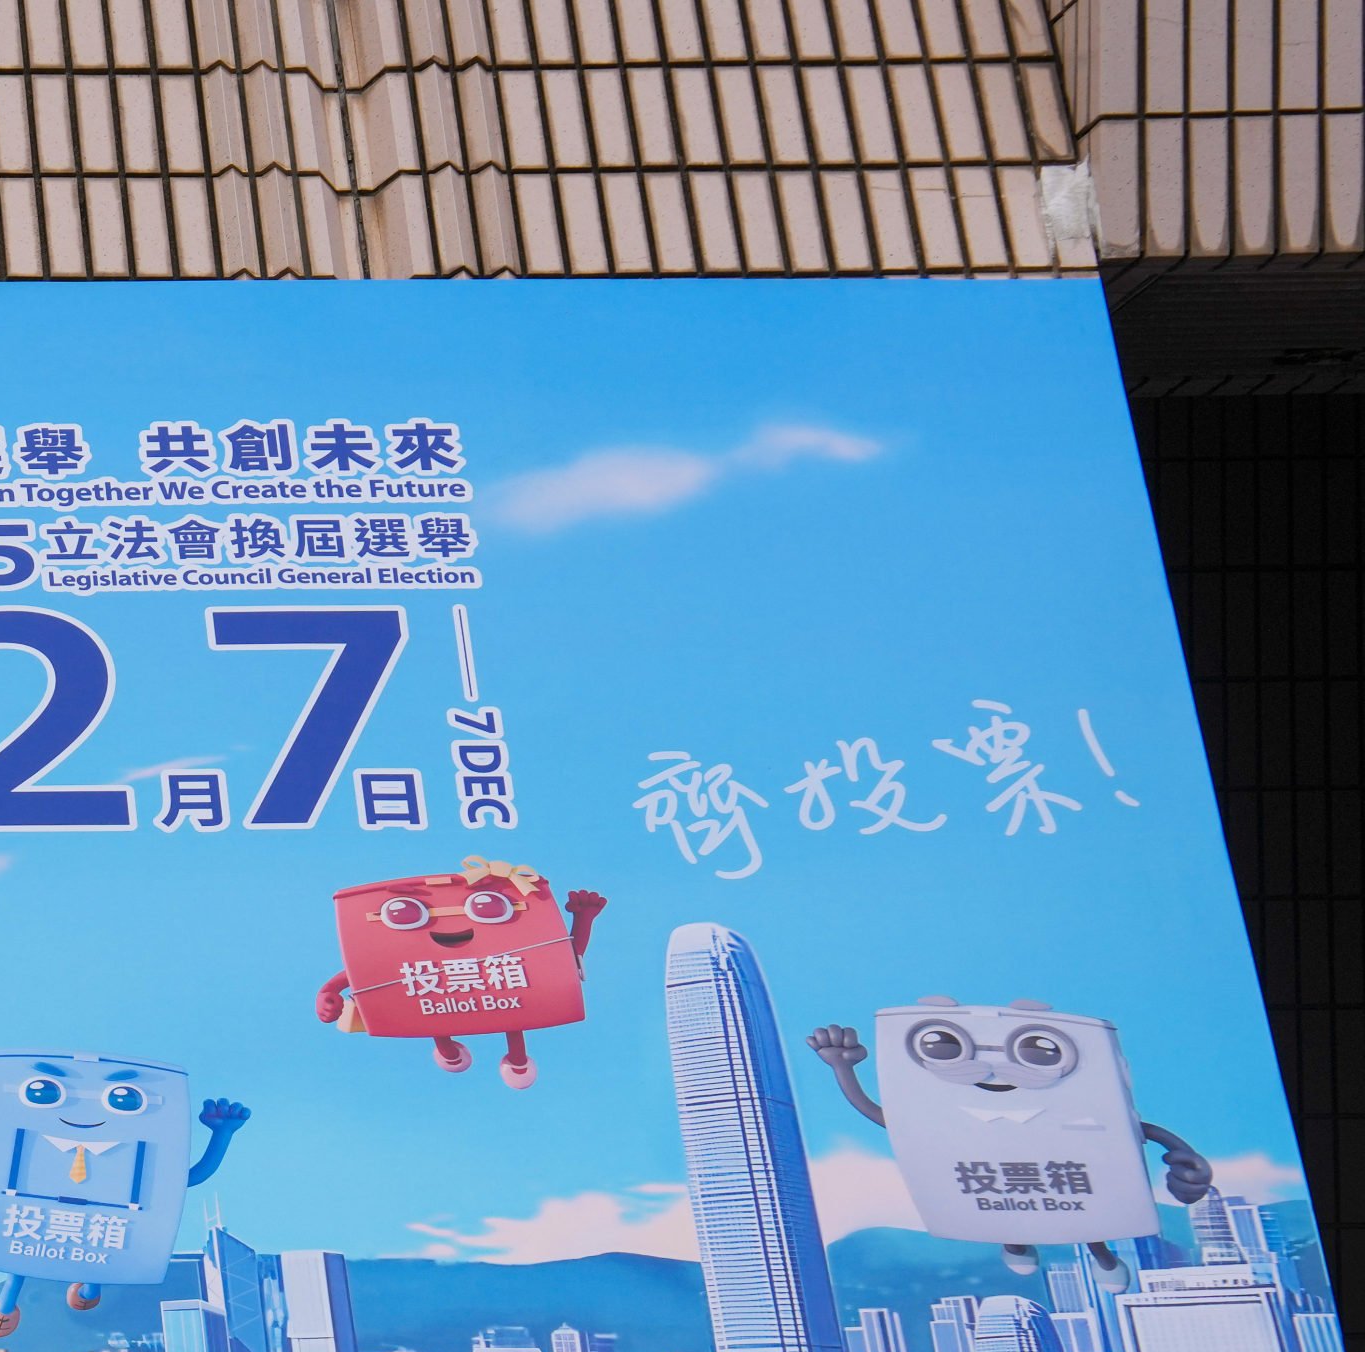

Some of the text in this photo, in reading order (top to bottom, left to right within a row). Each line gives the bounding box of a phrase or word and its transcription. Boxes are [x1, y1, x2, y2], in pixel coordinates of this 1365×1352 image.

[146, 423, 458, 473] 共創未來
[20, 481, 154, 507] Together
[158, 480, 205, 500] We
[211, 479, 307, 499] Create
[312, 478, 362, 498] the
[369, 478, 466, 498] Future
[46, 517, 471, 560] 立法會換屆選舉
[48, 567, 475, 591] Legislative Council General Election
[399, 955, 529, 997] 投票箱
[419, 994, 522, 1016] Ballot Box
[954, 1160, 1093, 1195] 投票箱
[976, 1197, 1086, 1212] Ballot Box
[2, 1204, 129, 1249] 投票箱
[9, 1240, 109, 1265] Ballot Box
